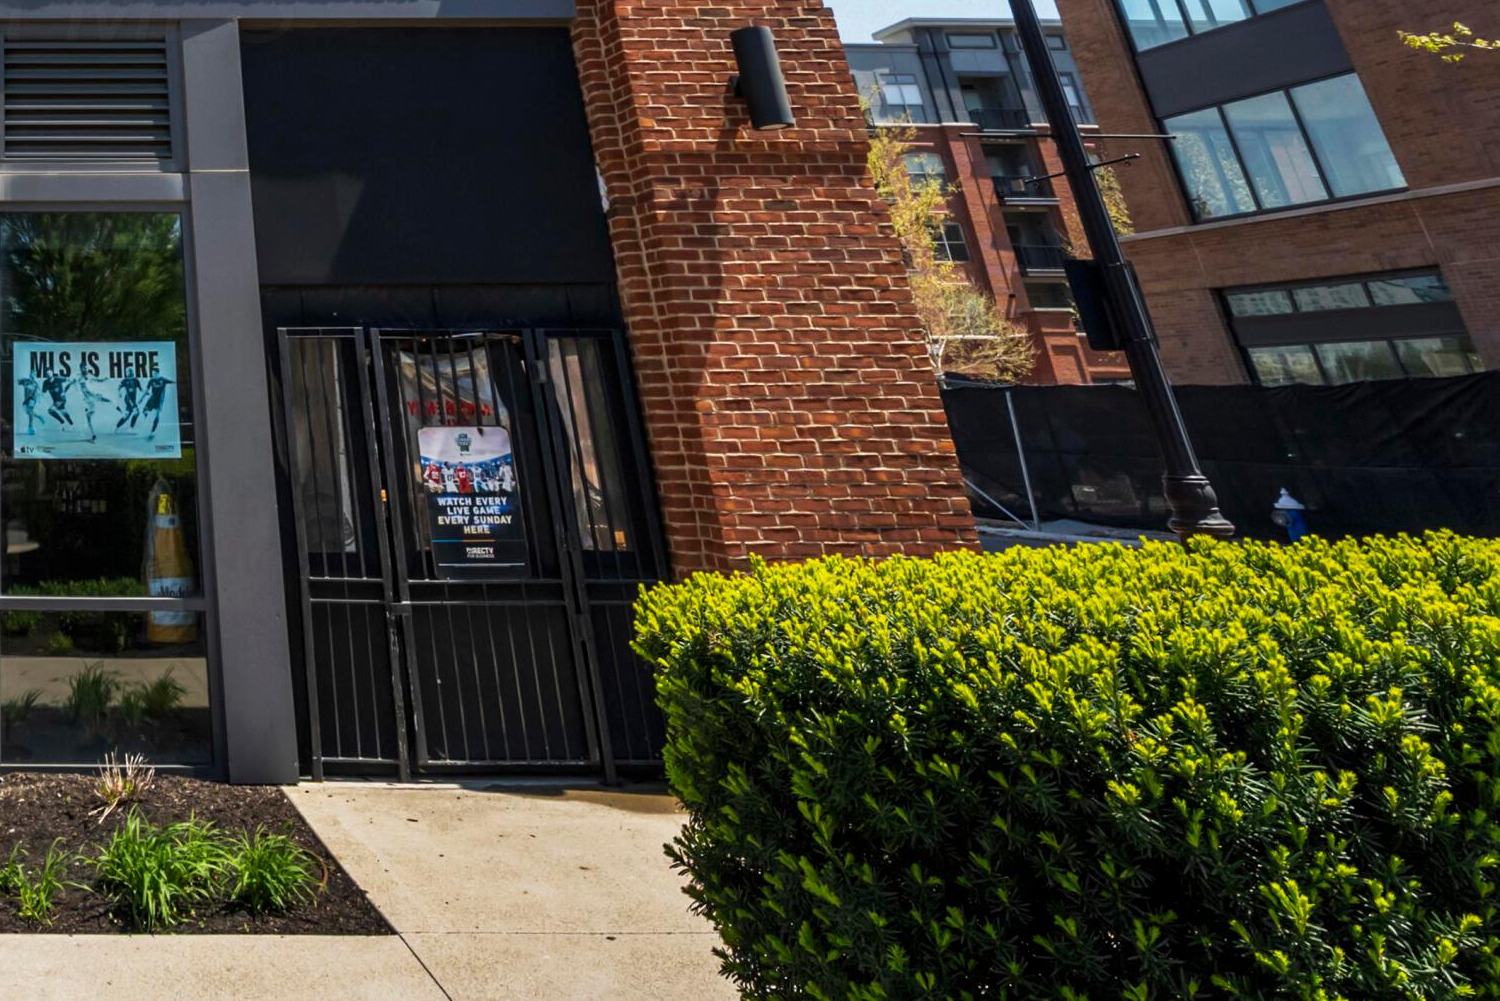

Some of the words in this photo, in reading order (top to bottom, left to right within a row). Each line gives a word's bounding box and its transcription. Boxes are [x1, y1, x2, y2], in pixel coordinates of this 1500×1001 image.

[30, 351, 71, 378] MLS
[81, 351, 100, 378] IS
[109, 351, 159, 378] HERE
[437, 497, 472, 506] WATCH
[476, 497, 508, 506] EVERY
[447, 506, 471, 515] LIVE
[473, 506, 501, 515] GAME
[438, 516, 469, 525] EVERY
[474, 515, 513, 525] SUNDAY
[463, 525, 491, 535] HERE
[466, 547, 494, 555] DIRECTV
